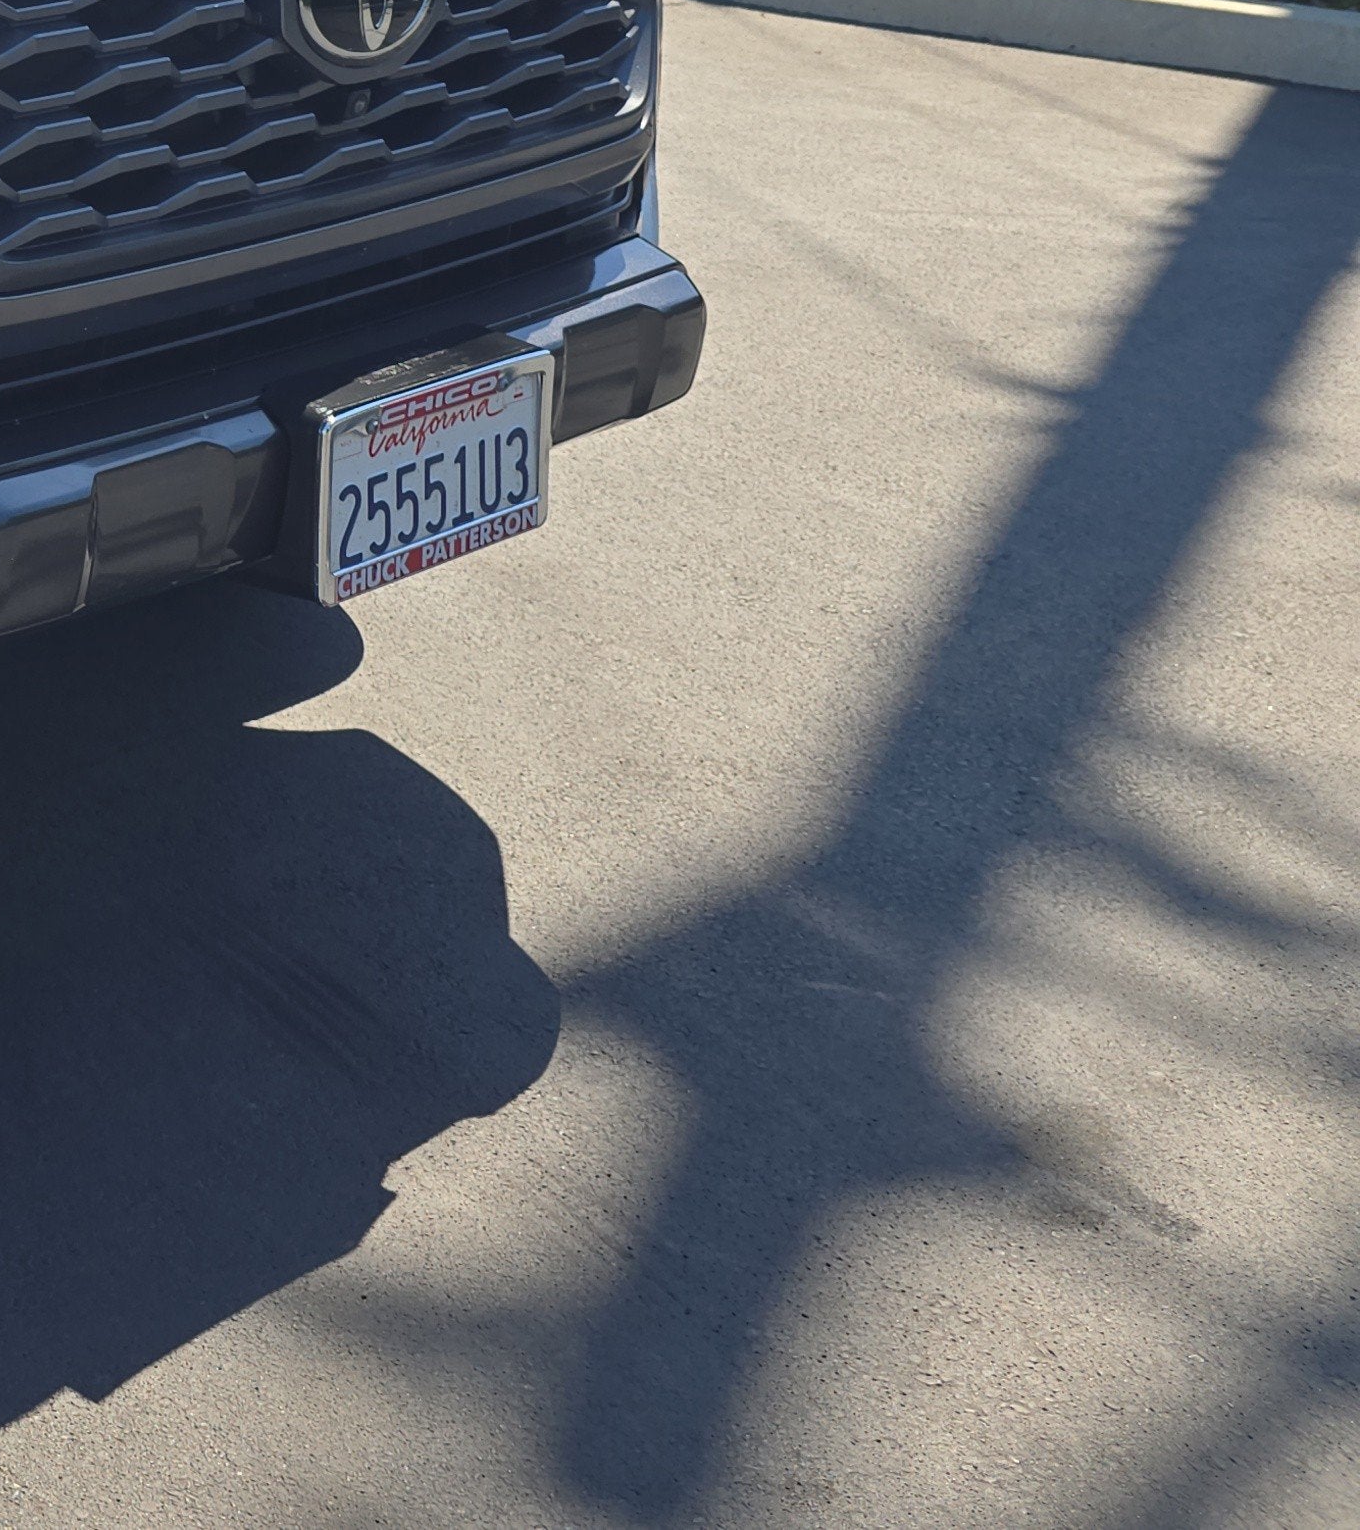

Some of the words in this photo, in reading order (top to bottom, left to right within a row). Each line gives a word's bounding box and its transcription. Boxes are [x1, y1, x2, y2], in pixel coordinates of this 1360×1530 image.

[369, 398, 504, 458] California
[381, 376, 498, 425] CHICO
[338, 427, 529, 569] 25551U3
[338, 556, 412, 598] CHUCK
[421, 506, 537, 566] PATTERSON
